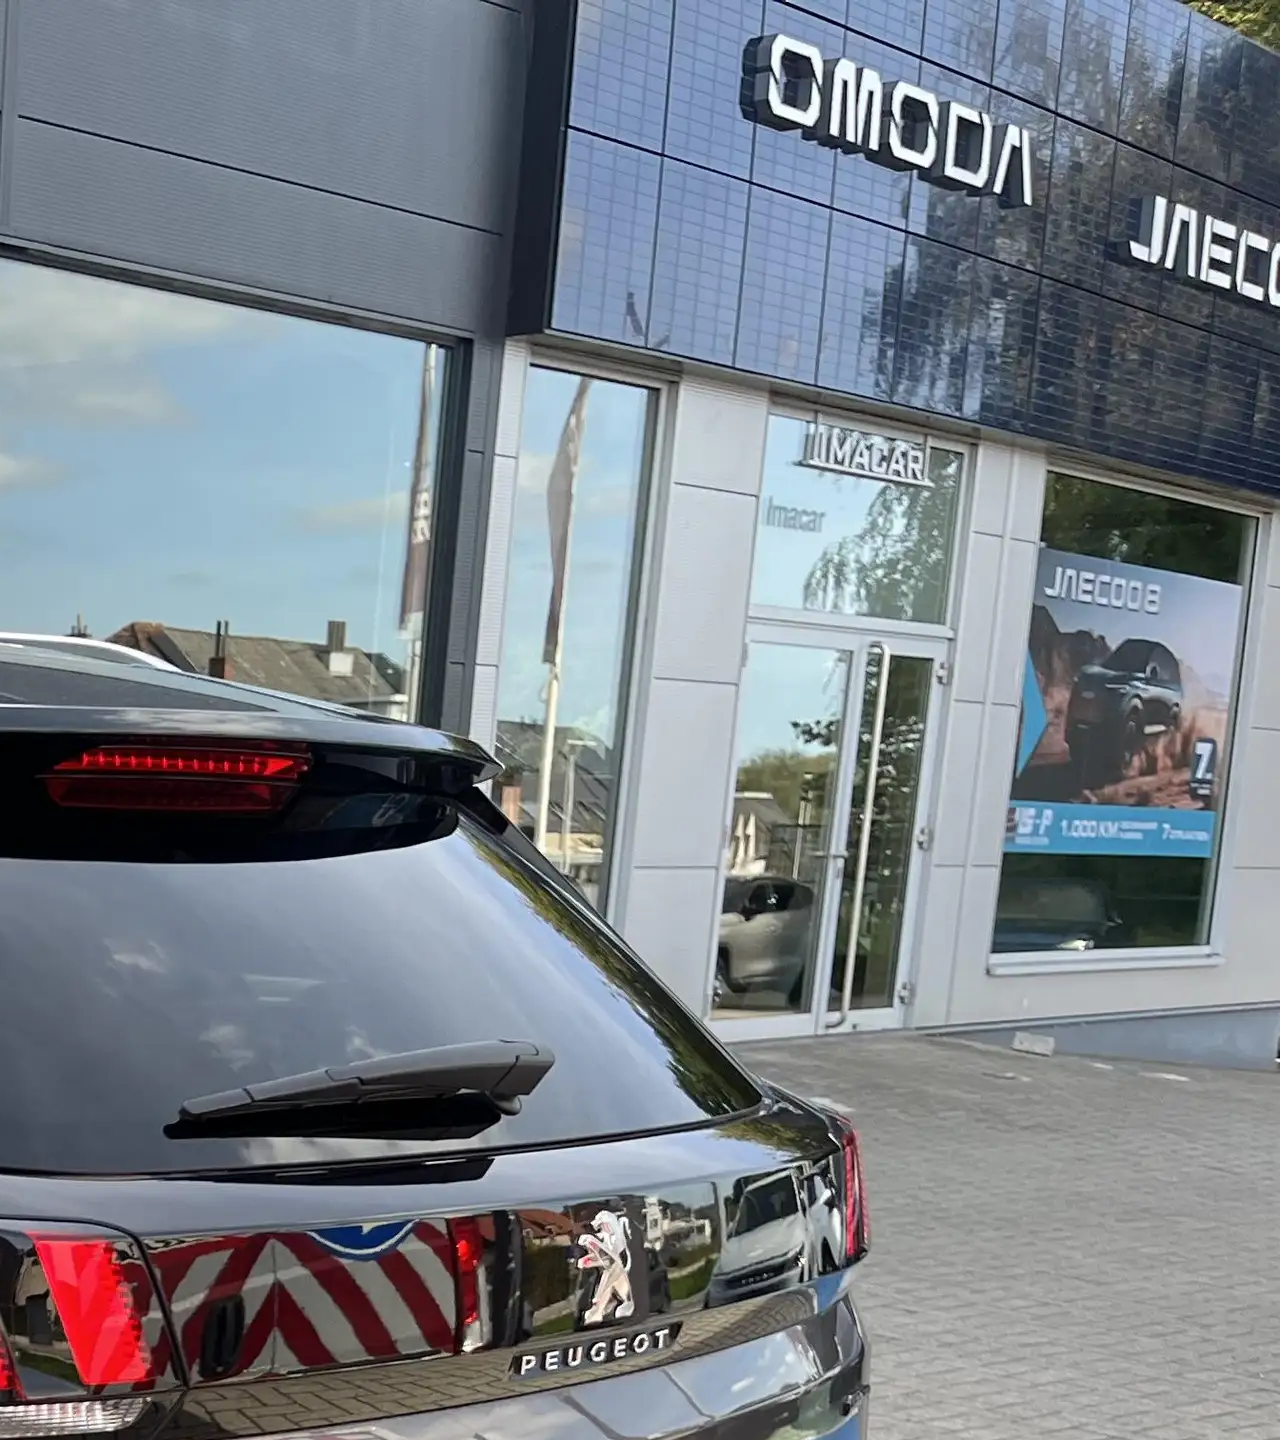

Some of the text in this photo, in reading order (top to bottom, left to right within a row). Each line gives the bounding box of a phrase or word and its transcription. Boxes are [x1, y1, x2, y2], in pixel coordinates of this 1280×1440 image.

[767, 33, 1033, 207] OMODA
[819, 425, 925, 481] IMACAR
[520, 1328, 670, 1376] PEUGEOT
